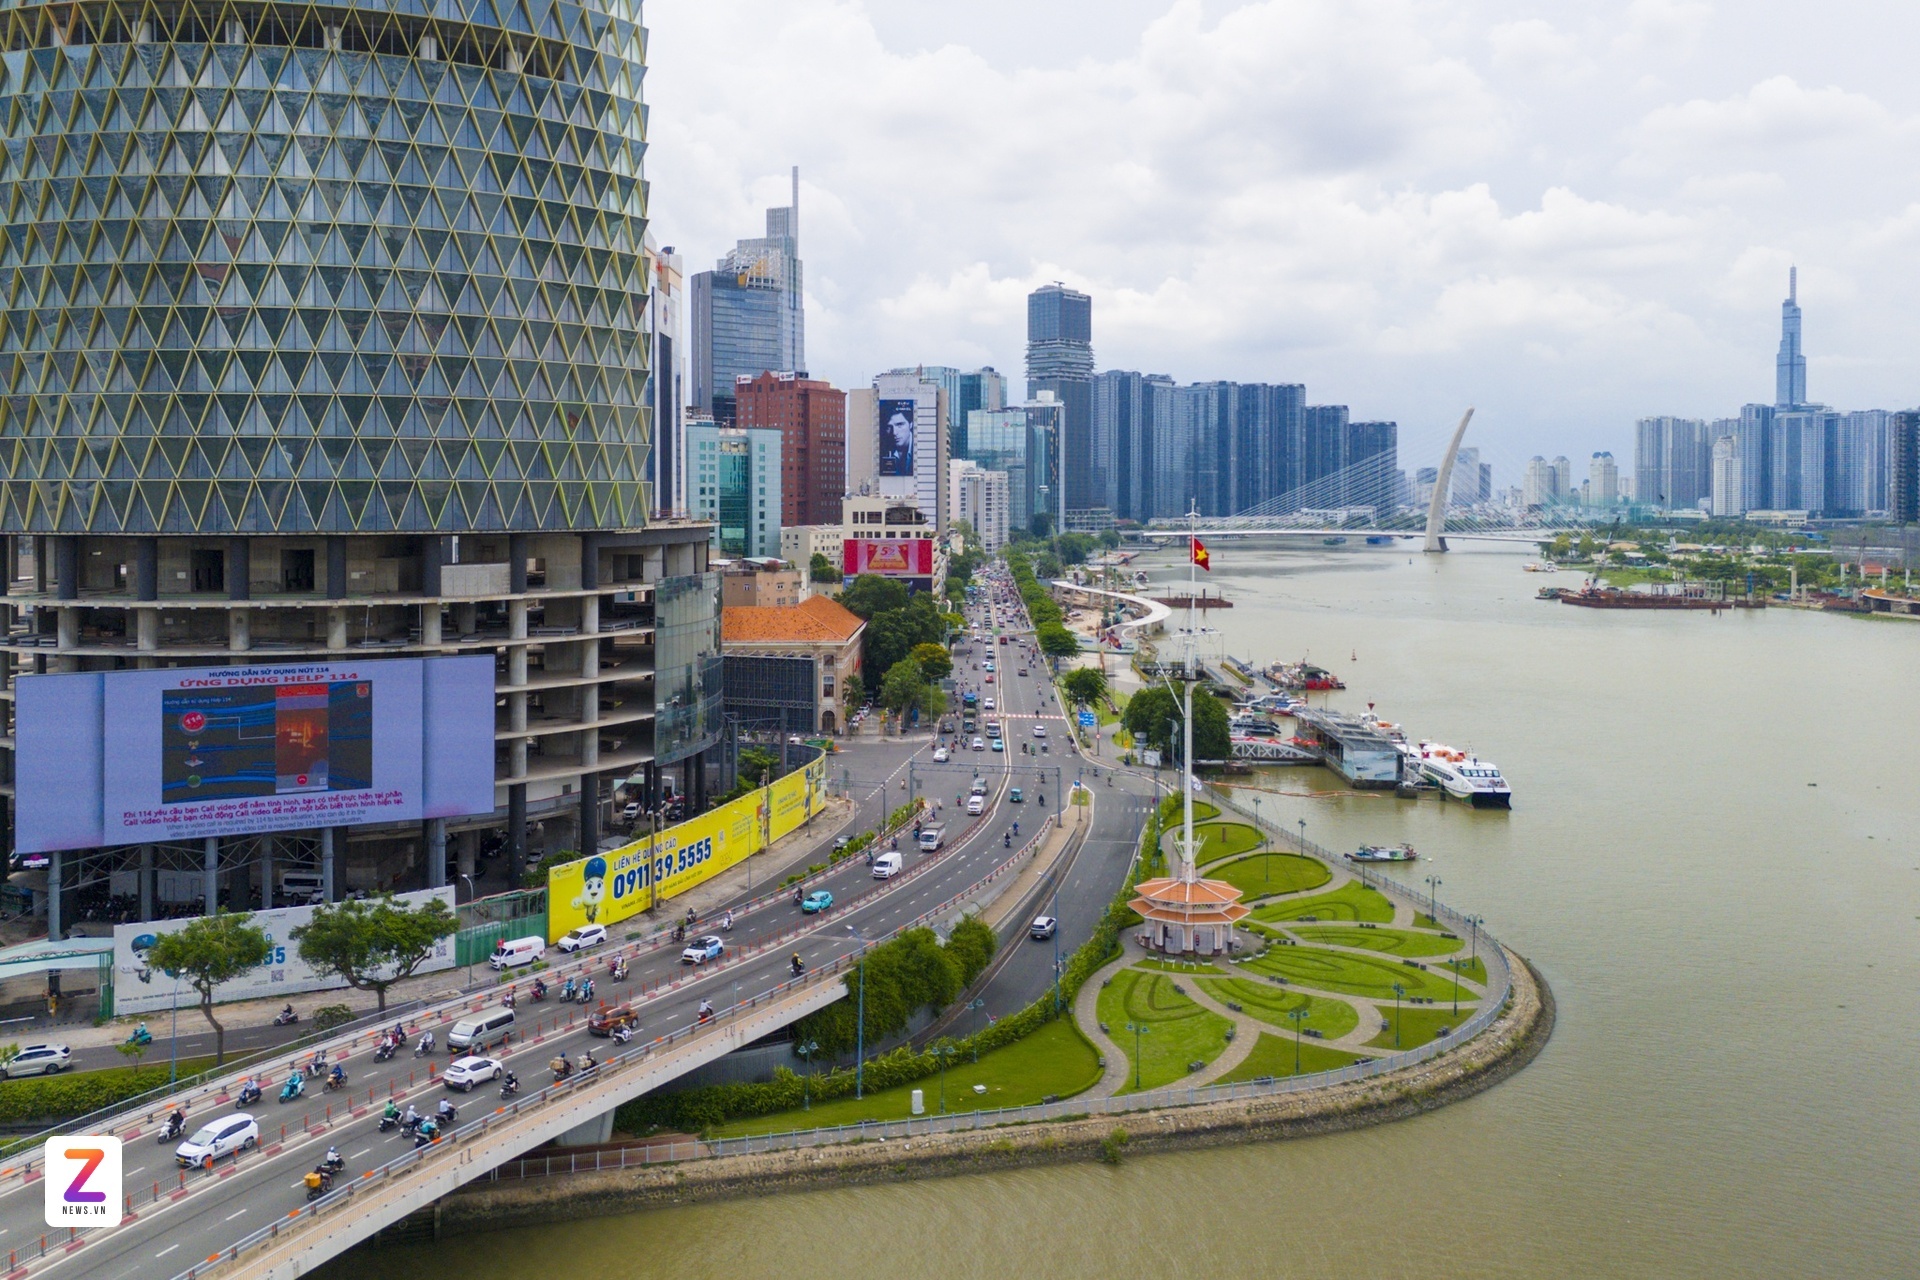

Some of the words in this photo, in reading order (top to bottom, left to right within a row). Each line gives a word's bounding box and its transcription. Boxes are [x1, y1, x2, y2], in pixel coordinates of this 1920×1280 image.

[180, 678, 222, 687] ỨNG
[228, 676, 278, 686] DỤNG
[185, 715, 202, 725] 114
[614, 856, 630, 870] LIÊN
[632, 851, 640, 864] HỆ
[643, 842, 663, 859] QUNG
